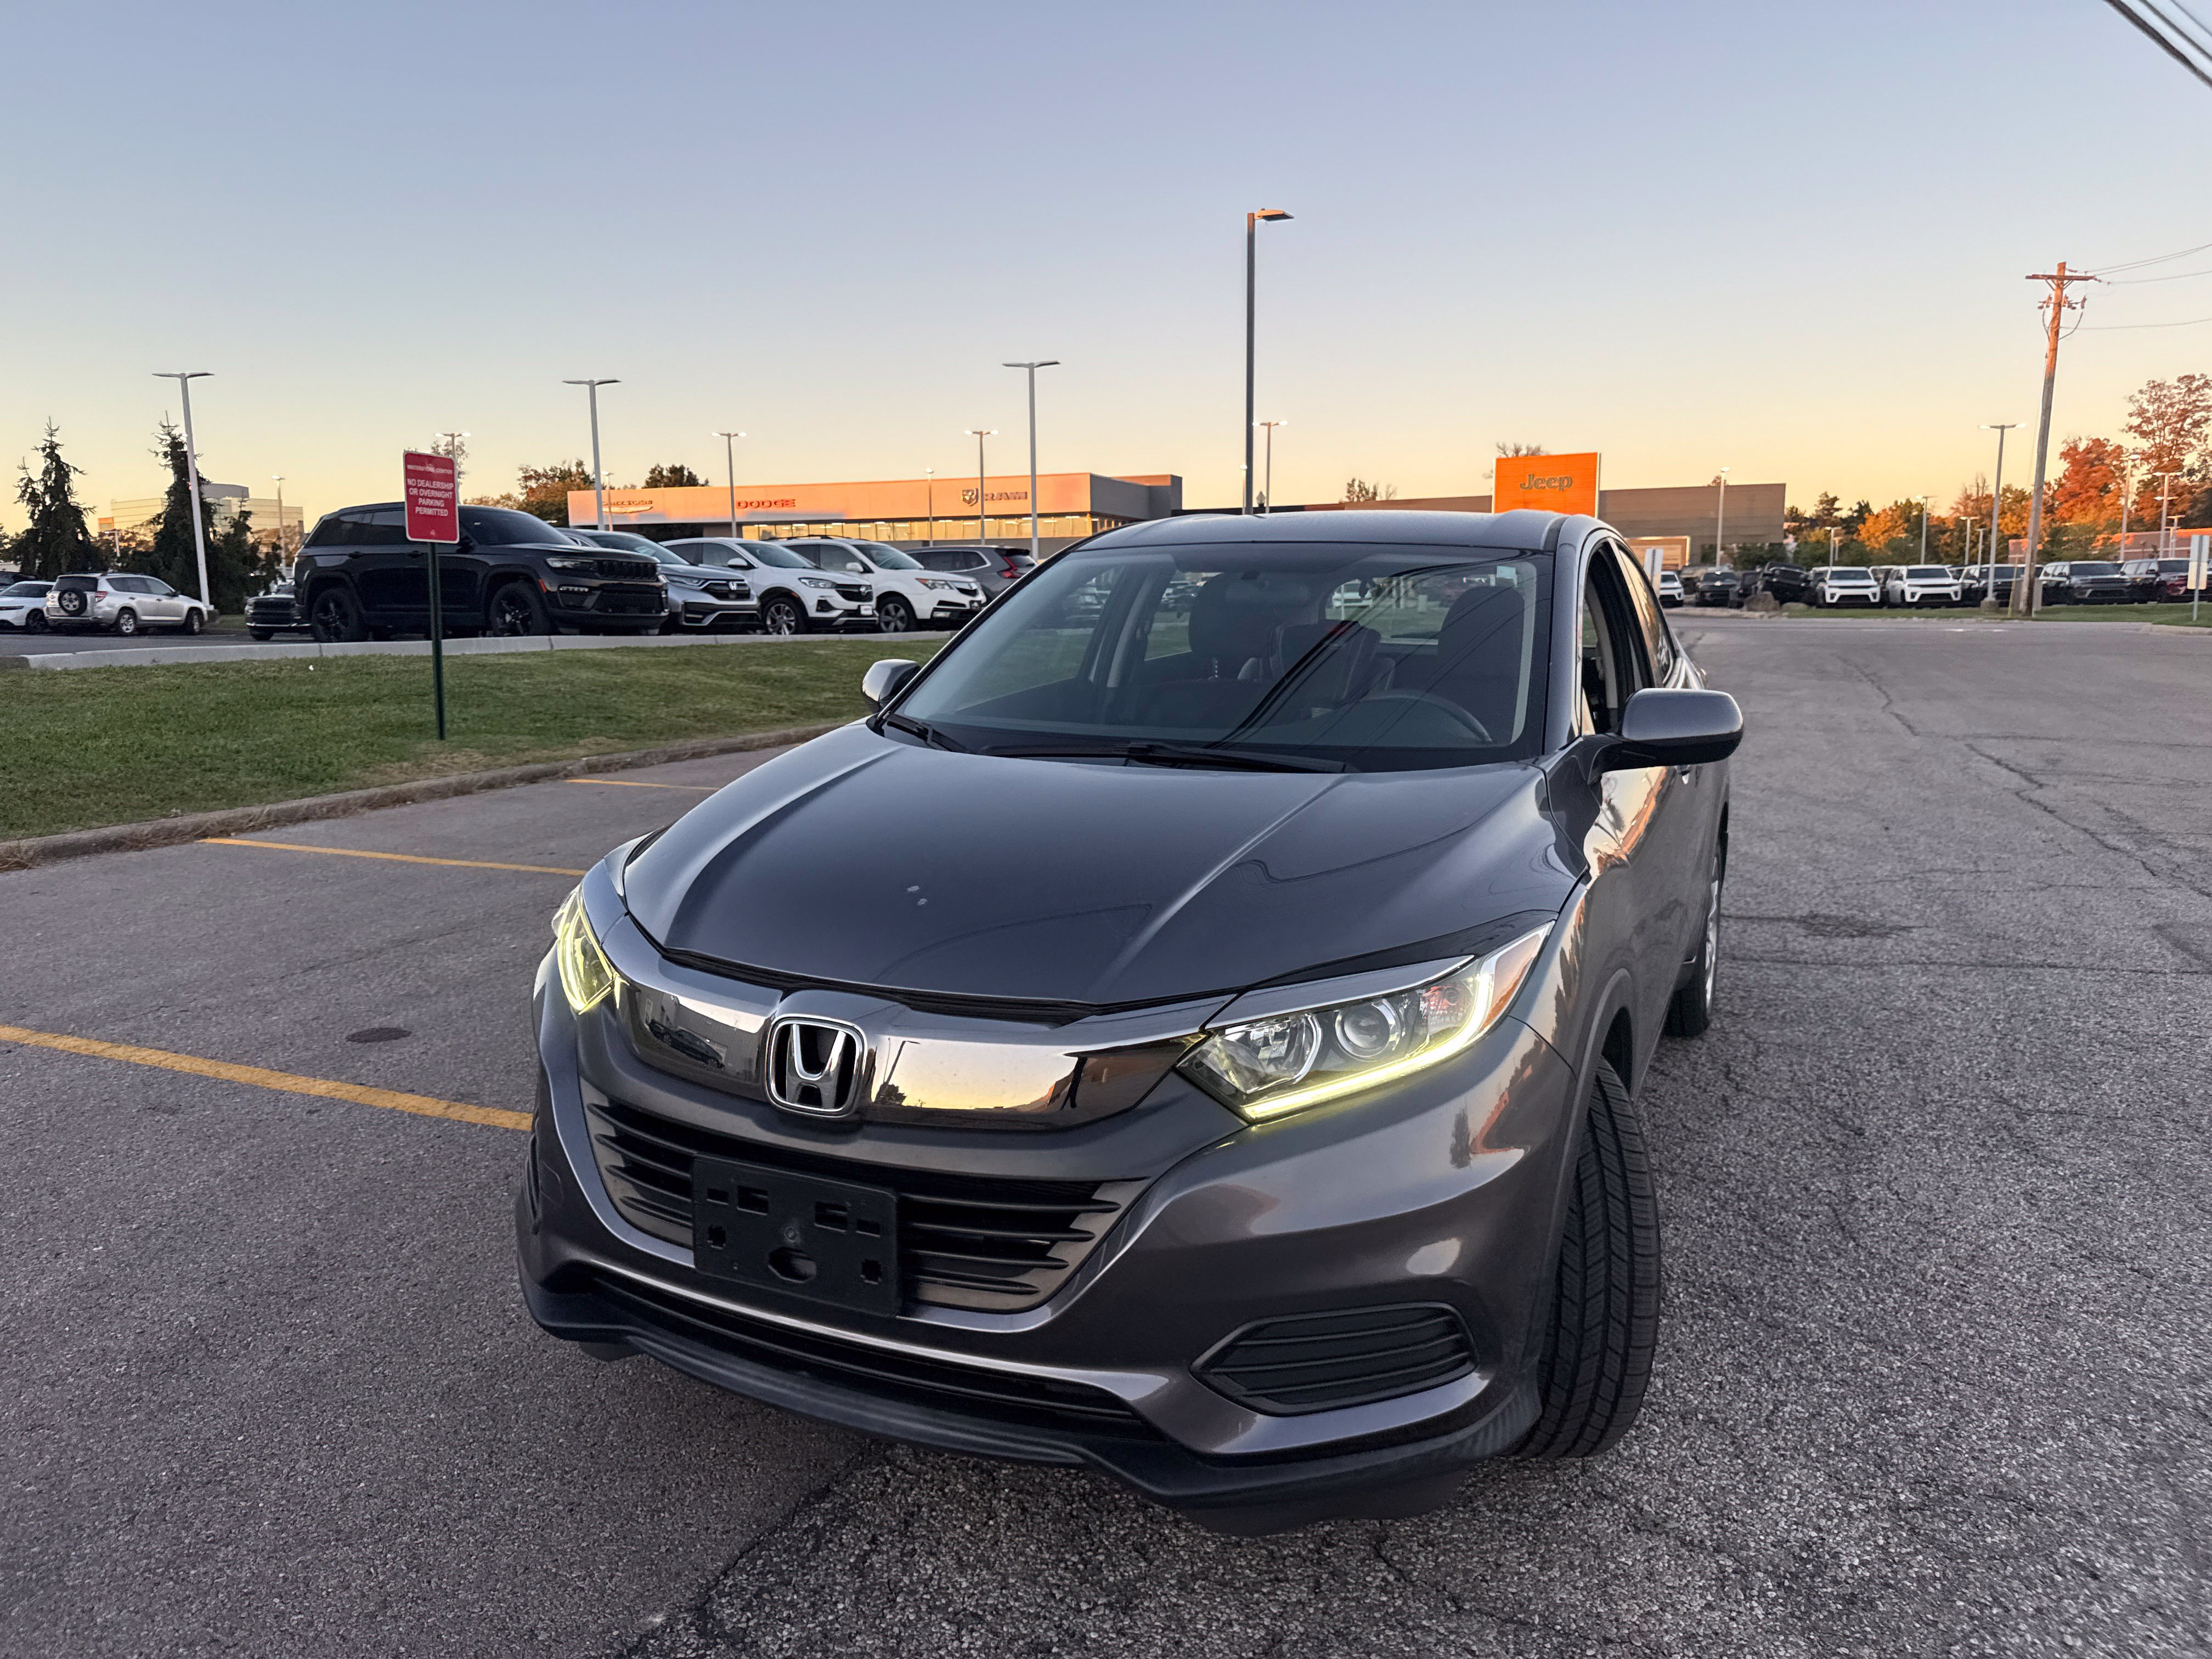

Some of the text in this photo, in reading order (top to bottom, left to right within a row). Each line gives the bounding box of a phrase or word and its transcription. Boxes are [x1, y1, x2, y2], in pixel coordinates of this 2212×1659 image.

[417, 479, 454, 489] DEALERSHIP
[1519, 473, 1572, 491] Jeep
[419, 489, 453, 499] OVERNIGHT
[984, 492, 1028, 501] RAM
[418, 498, 444, 507] PARKING
[736, 499, 796, 509] DODGE
[415, 507, 448, 516] PERMITTED
